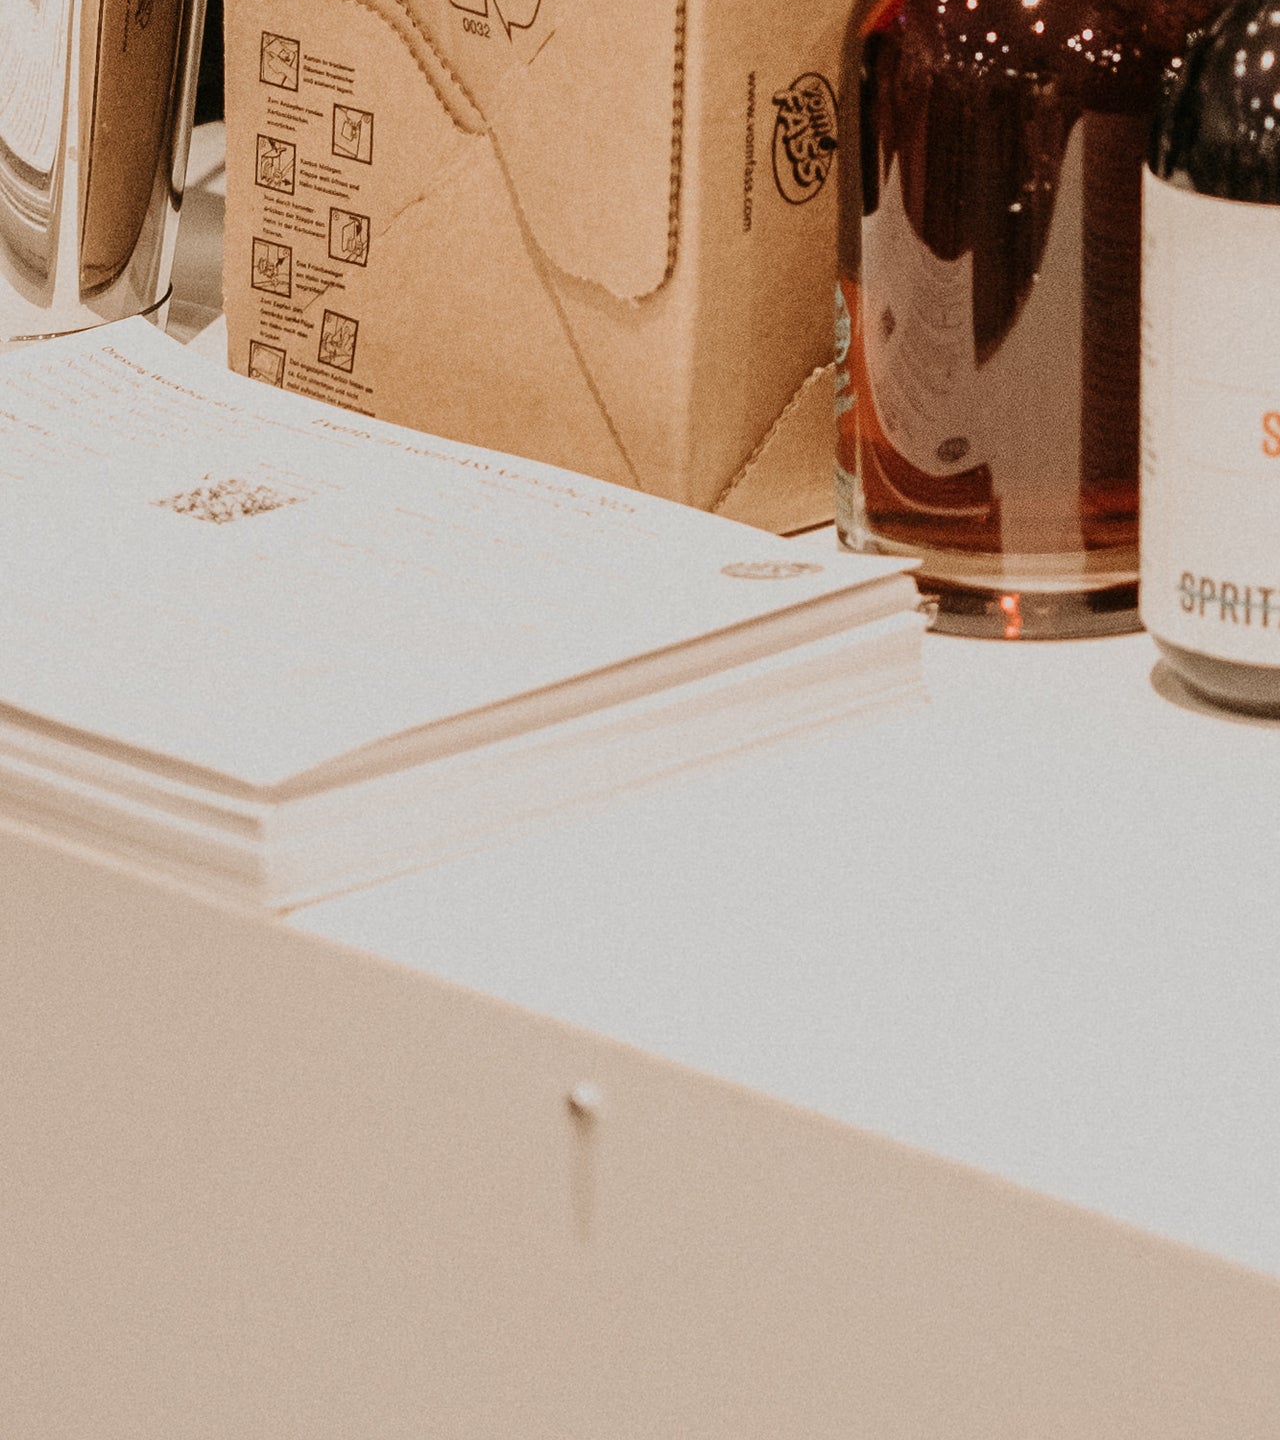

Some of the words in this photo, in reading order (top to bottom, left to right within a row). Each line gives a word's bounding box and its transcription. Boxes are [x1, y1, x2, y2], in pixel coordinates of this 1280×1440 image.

[463, 17, 491, 39] 0032
[772, 90, 826, 188] FASS
[804, 85, 832, 137] vom
[743, 71, 758, 233] www.vomfass.com
